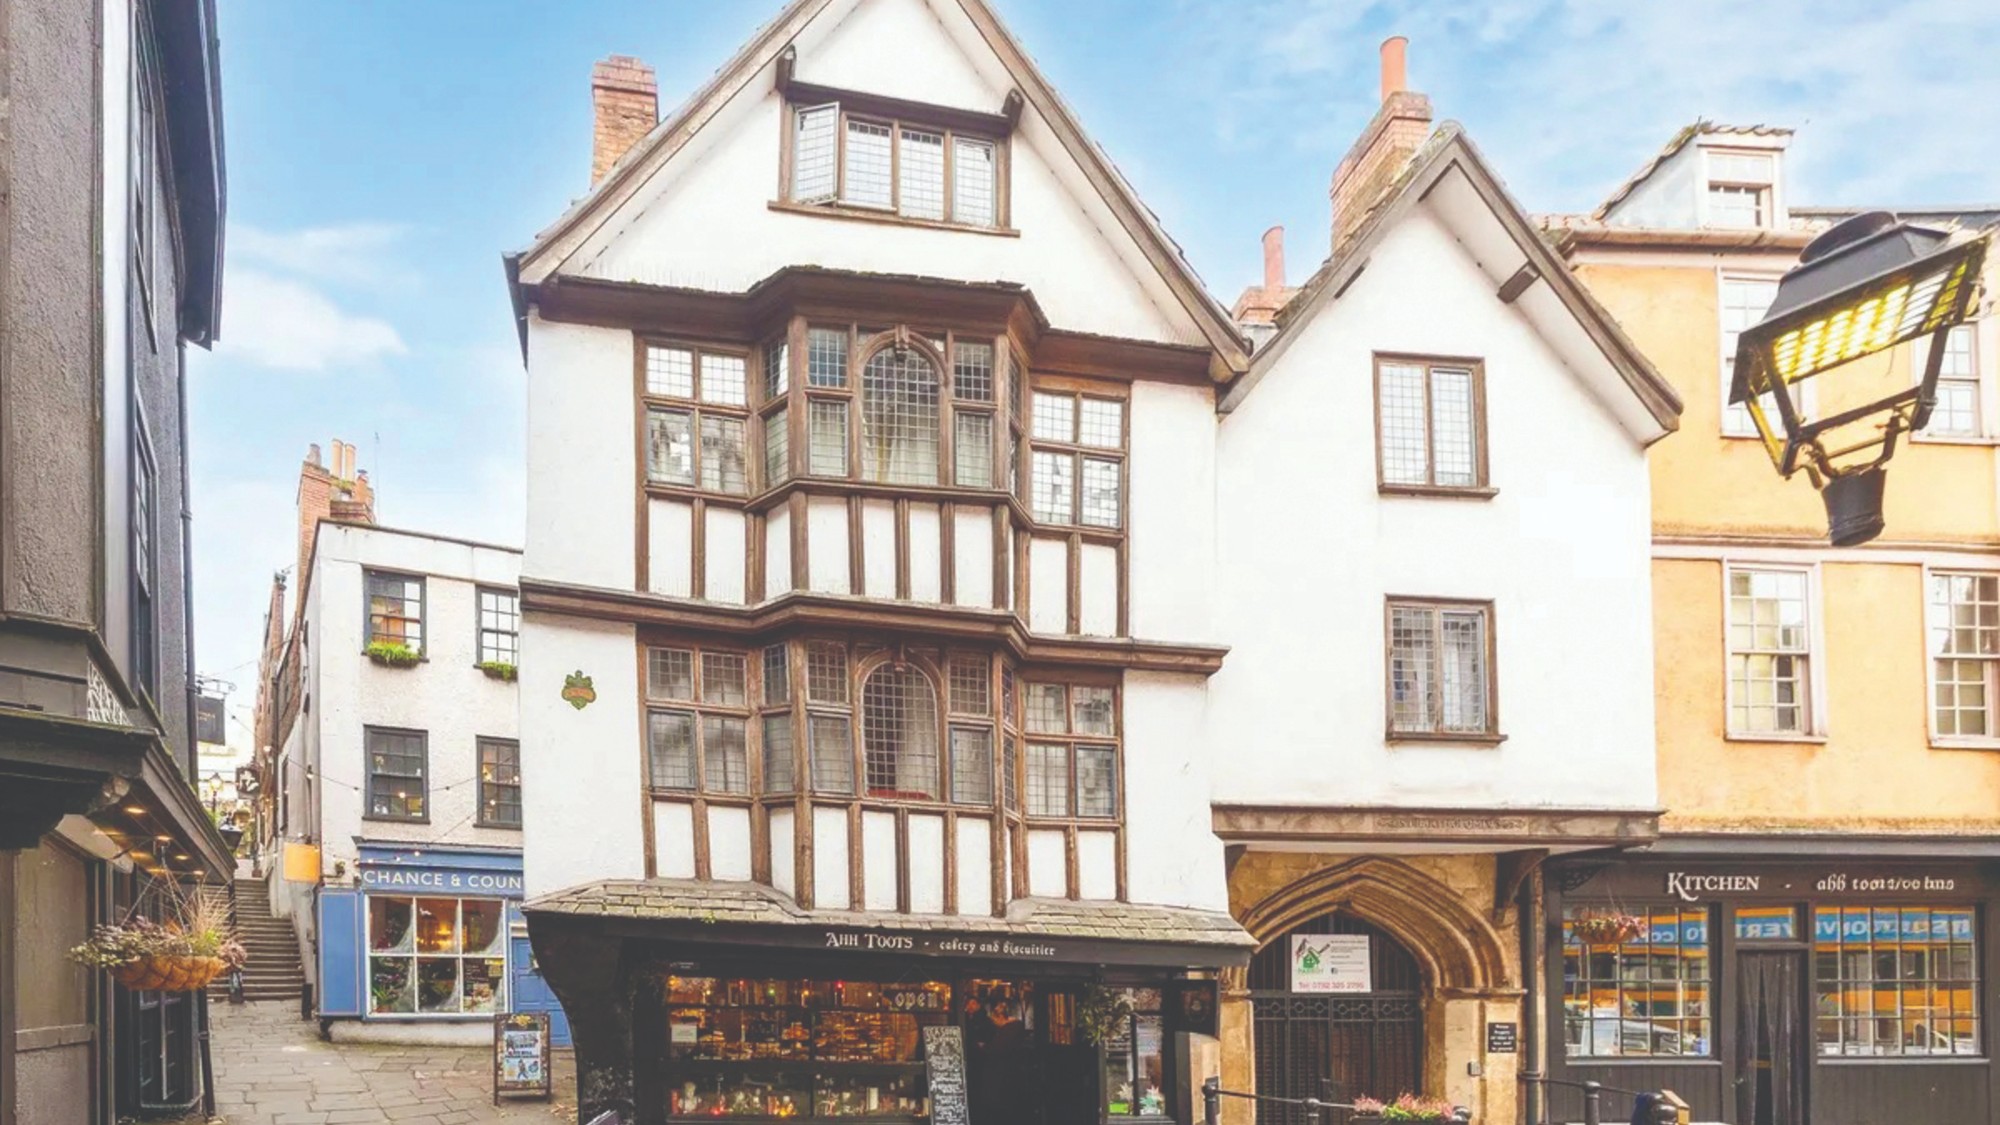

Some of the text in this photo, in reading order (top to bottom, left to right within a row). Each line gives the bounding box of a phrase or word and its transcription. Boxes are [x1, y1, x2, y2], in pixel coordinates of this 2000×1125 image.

[364, 870, 522, 889] CHANCE & COUN
[1667, 872, 1760, 902] KITCHEN
[979, 940, 1000, 953] and
[894, 991, 938, 1011] open
